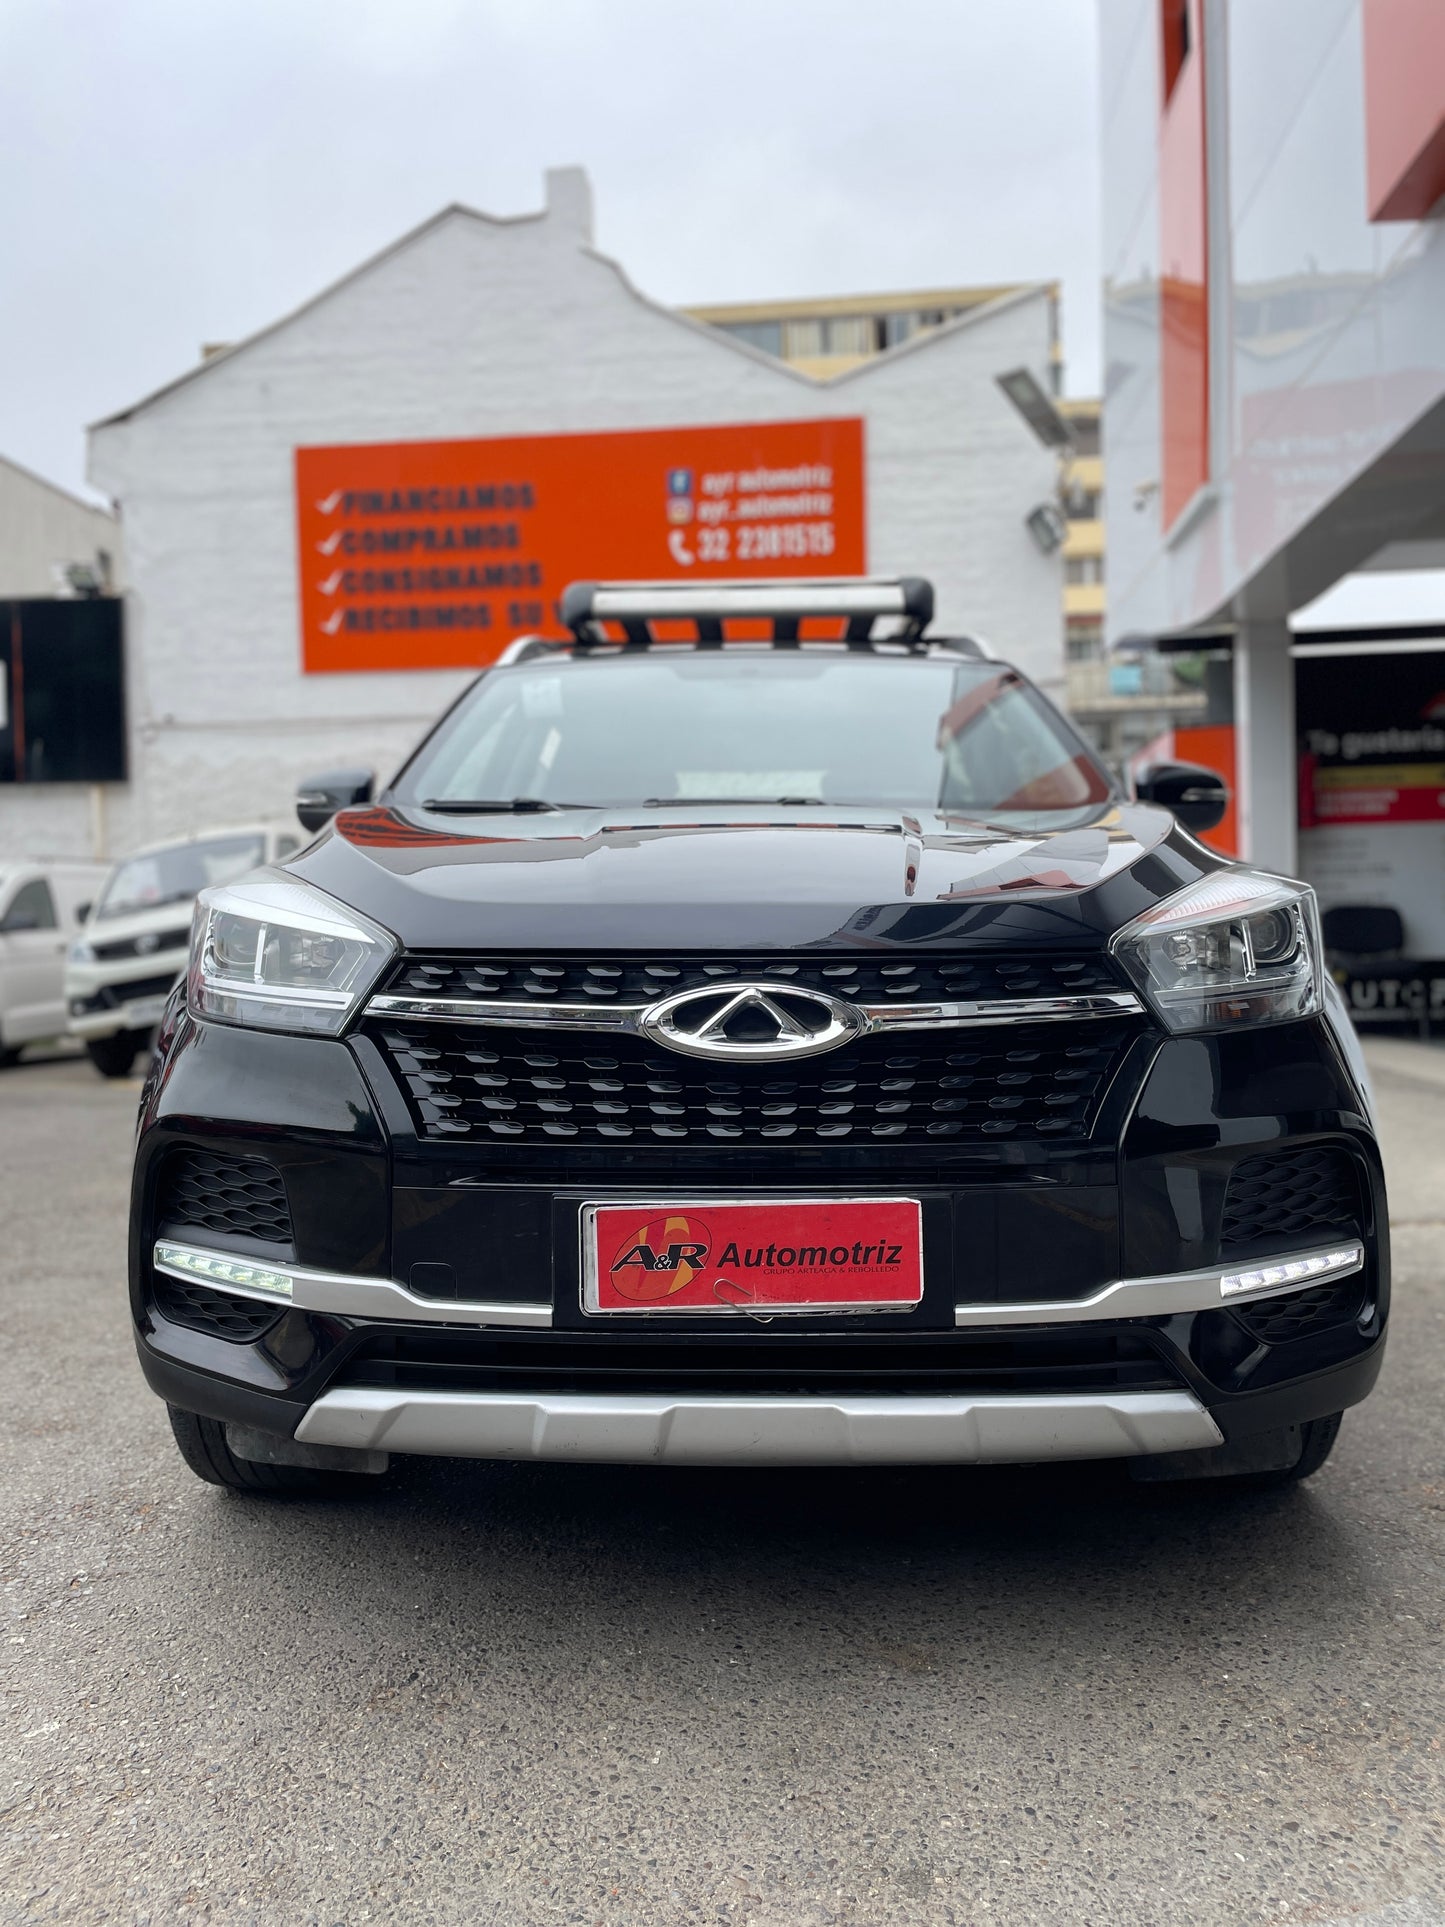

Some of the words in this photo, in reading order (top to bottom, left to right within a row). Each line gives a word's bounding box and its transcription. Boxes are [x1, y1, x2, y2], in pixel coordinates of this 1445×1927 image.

[343, 484, 534, 516] FINANCIAMOS
[343, 522, 519, 556] COMPRAMOS
[699, 527, 730, 561] 32
[343, 561, 543, 595] CONSIGNAMOS
[344, 602, 492, 634] RECIBIMOS
[508, 601, 542, 629] SU
[609, 1242, 709, 1273] A&R
[717, 1239, 903, 1268] Automotriz
